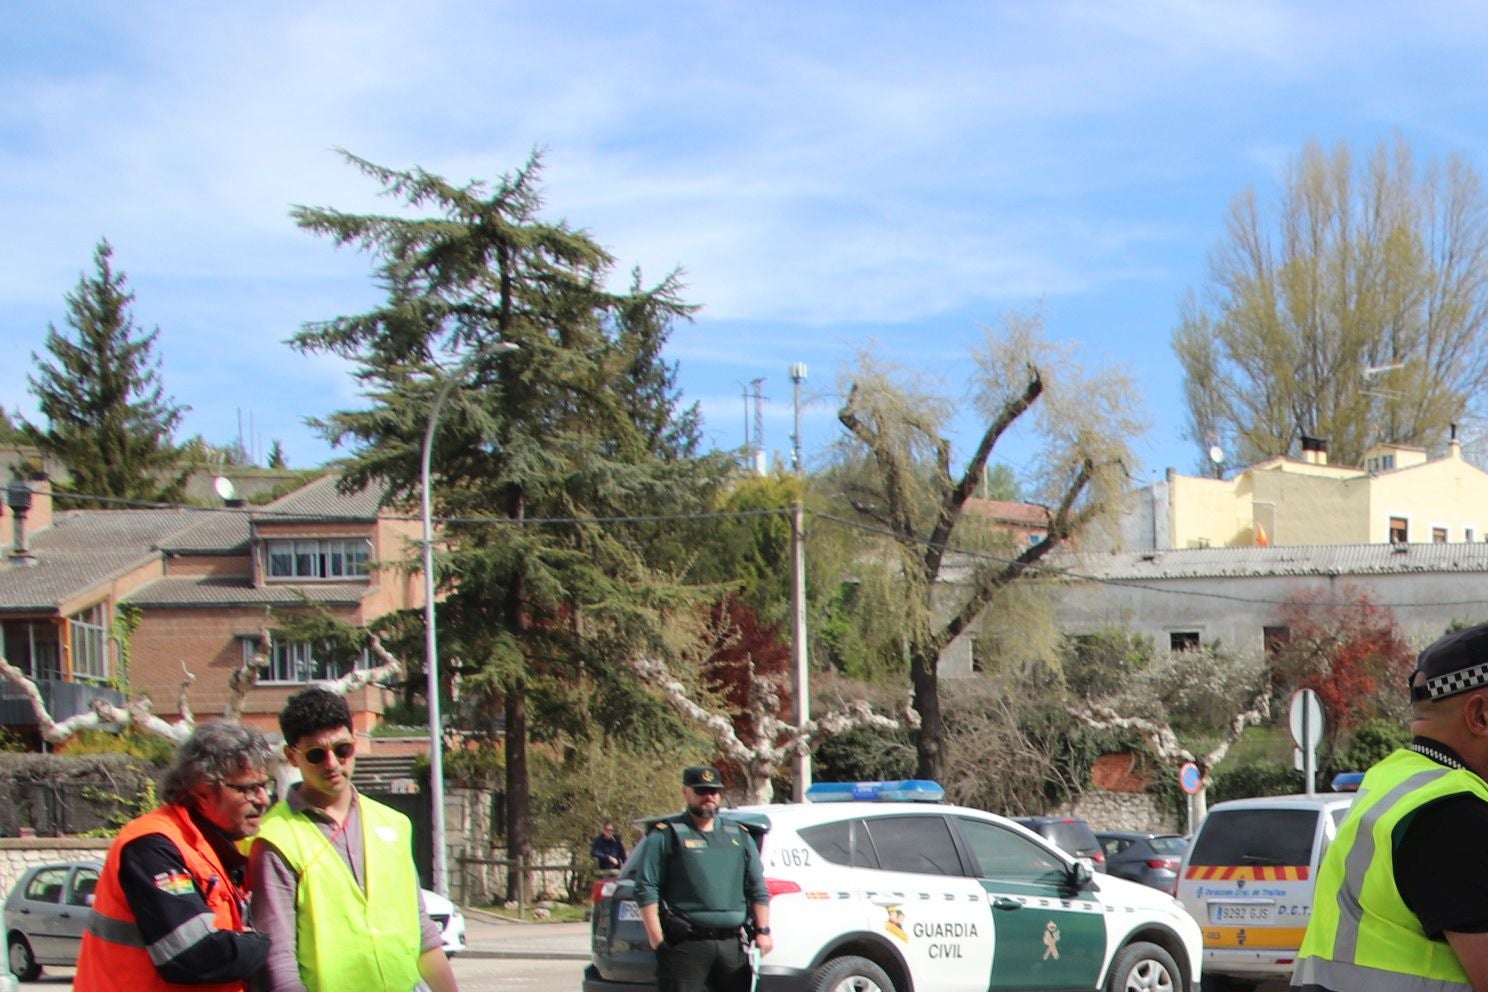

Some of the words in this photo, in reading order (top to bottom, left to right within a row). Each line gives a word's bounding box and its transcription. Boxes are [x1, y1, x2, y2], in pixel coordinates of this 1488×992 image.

[782, 849, 812, 867] 062
[1223, 907, 1246, 919] 9292
[1250, 907, 1269, 919] GJS
[913, 923, 979, 938] GUARDIA
[928, 944, 964, 959] CIVIL
